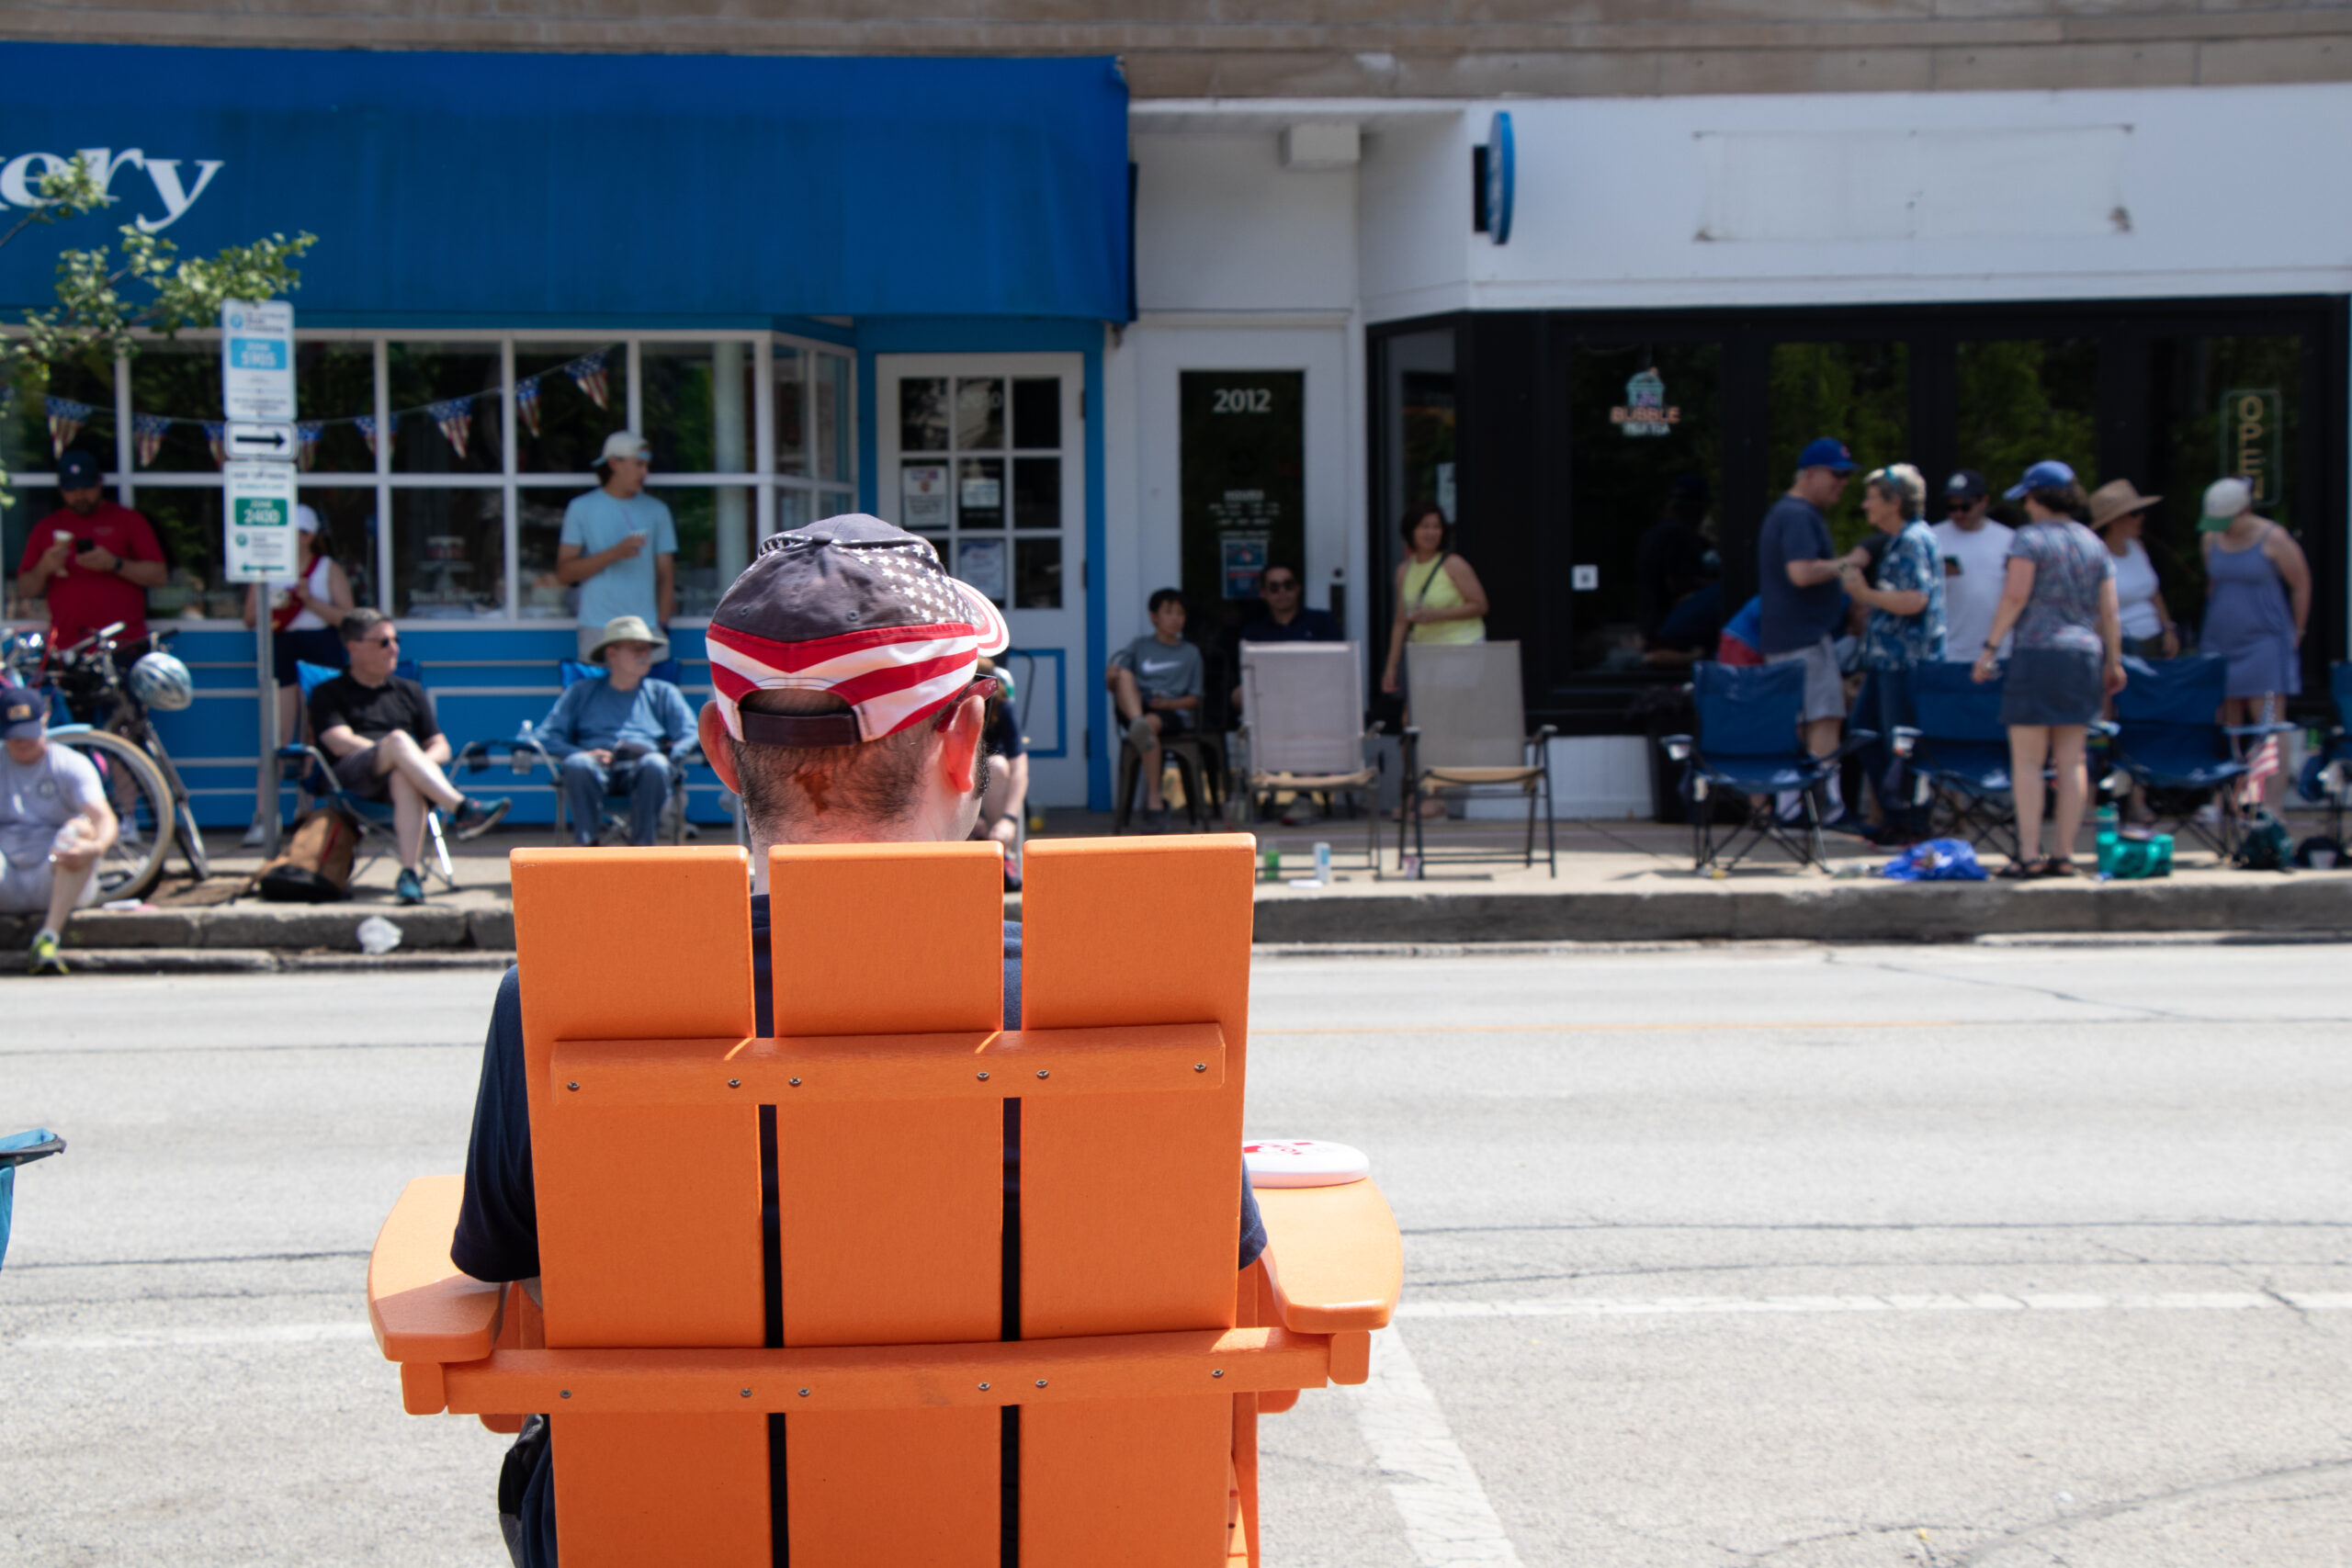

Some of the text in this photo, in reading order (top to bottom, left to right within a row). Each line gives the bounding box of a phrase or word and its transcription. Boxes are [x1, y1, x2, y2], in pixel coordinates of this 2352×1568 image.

[0, 147, 225, 233] ery
[1213, 388, 1272, 412] 2012
[1611, 406, 1680, 423] BUBBLE
